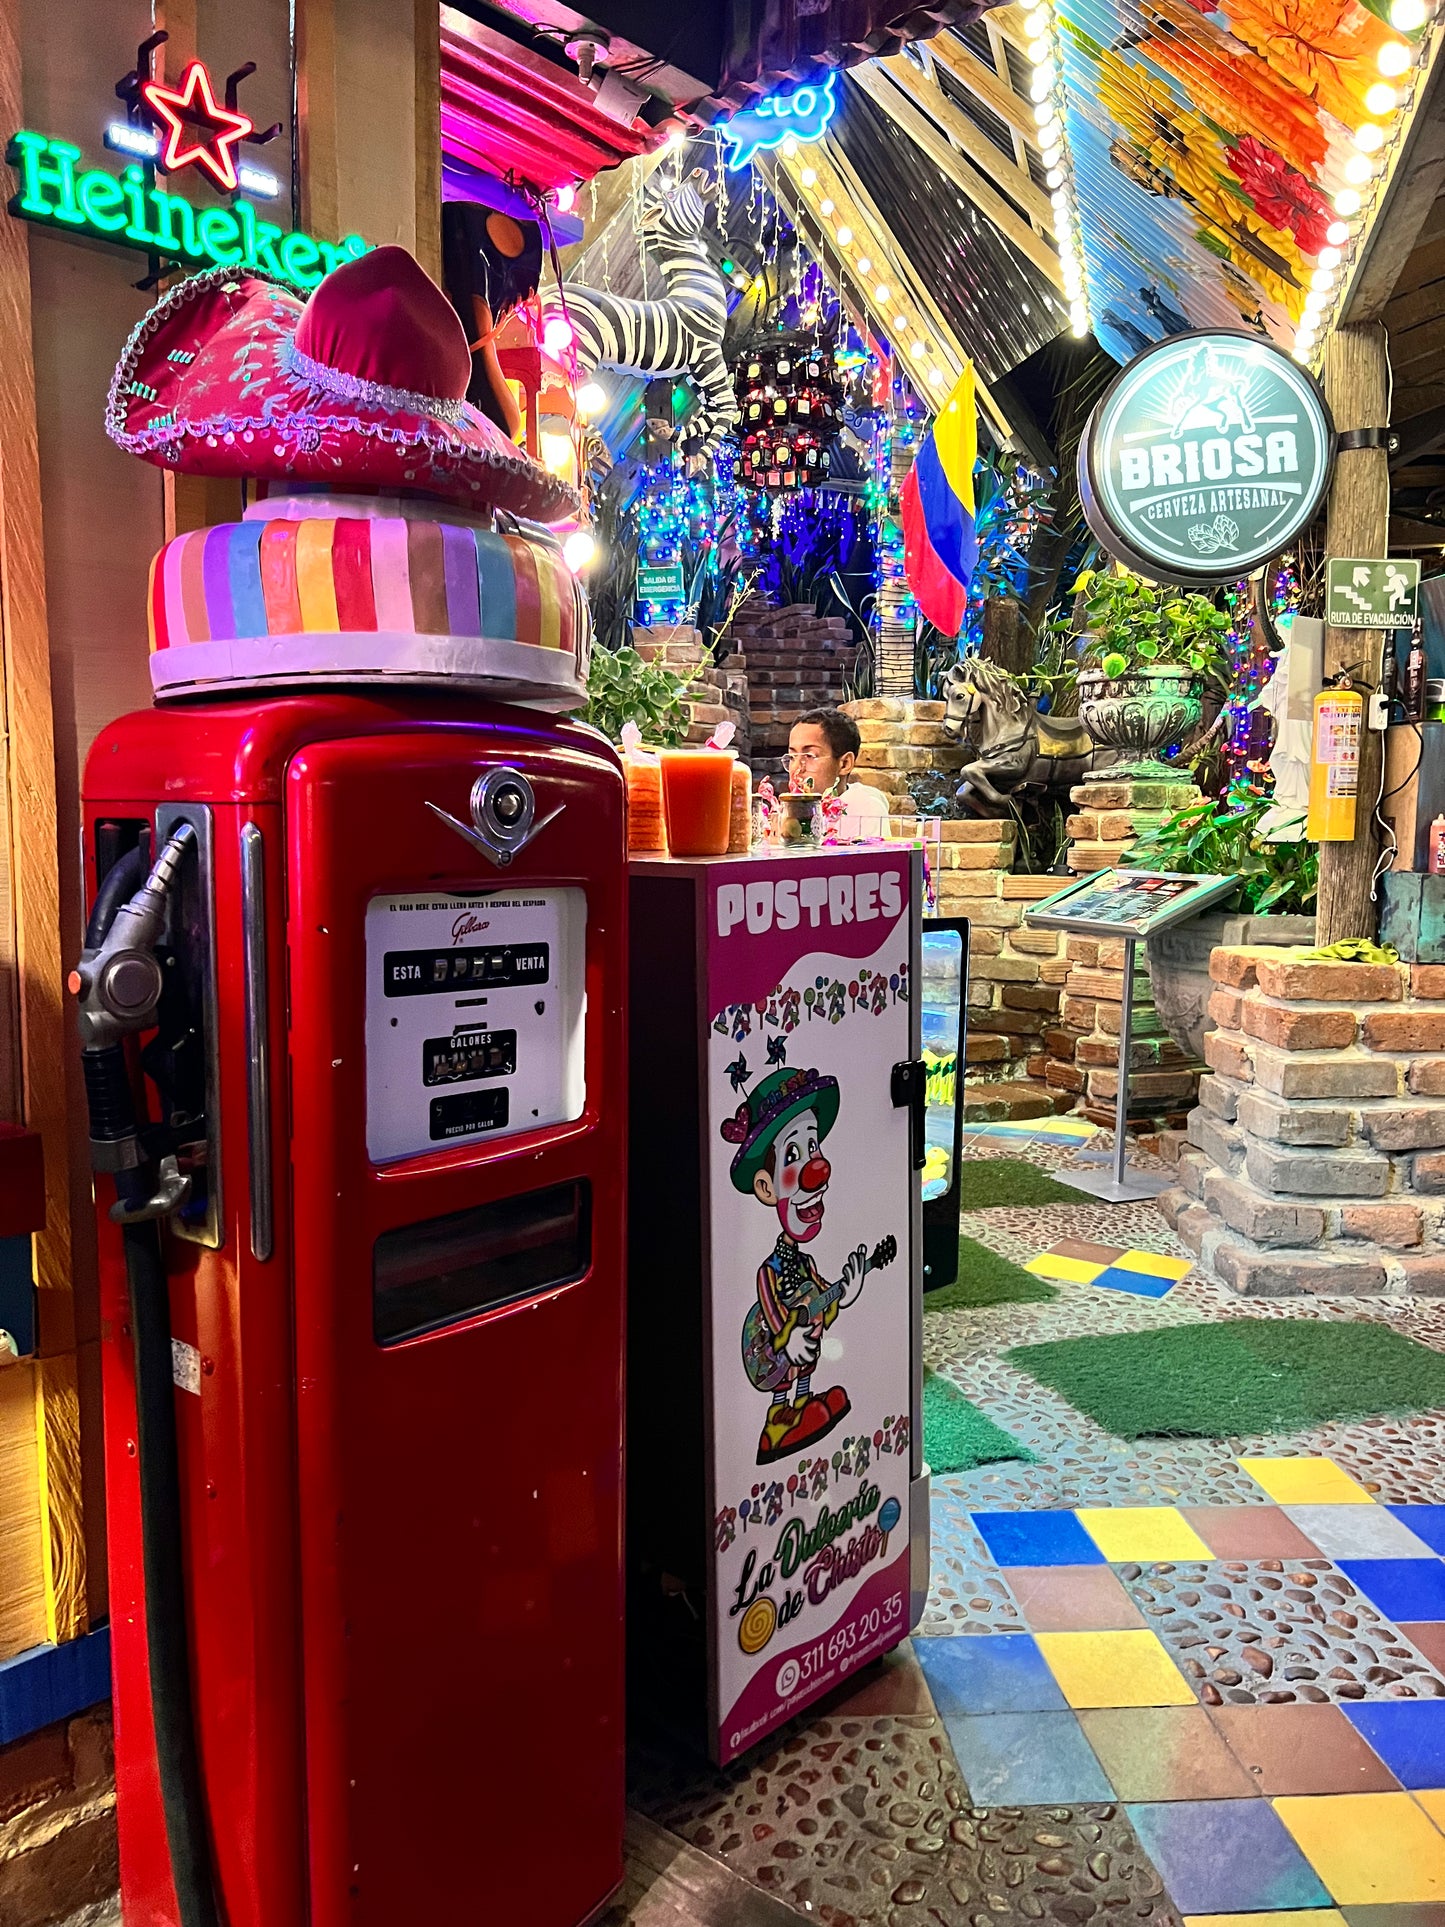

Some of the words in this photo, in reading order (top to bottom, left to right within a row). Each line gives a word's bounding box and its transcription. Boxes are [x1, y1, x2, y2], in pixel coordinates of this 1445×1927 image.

[1119, 430, 1299, 491] BRIOSA
[1147, 493, 1205, 520] CERVEZA
[1209, 488, 1287, 517] ARTESANAL
[643, 576, 666, 584] SALIDA
[667, 575, 677, 583] DE
[1331, 612, 1350, 623] RUTA
[1352, 612, 1364, 624] DE
[1365, 610, 1414, 625] EVACUACIÓN
[717, 871, 901, 937] POSTRES
[393, 966, 421, 981] ESTA
[516, 957, 545, 971] VENTA
[450, 1034, 492, 1049] GALONES
[445, 1125, 464, 1134] PRECIO
[465, 1123, 476, 1131] POR
[729, 1549, 777, 1617] La
[777, 1590, 805, 1629] de
[800, 1642, 825, 1680] 311
[828, 1622, 856, 1661] 693
[859, 1608, 881, 1642] 20
[882, 1592, 903, 1624] 35
